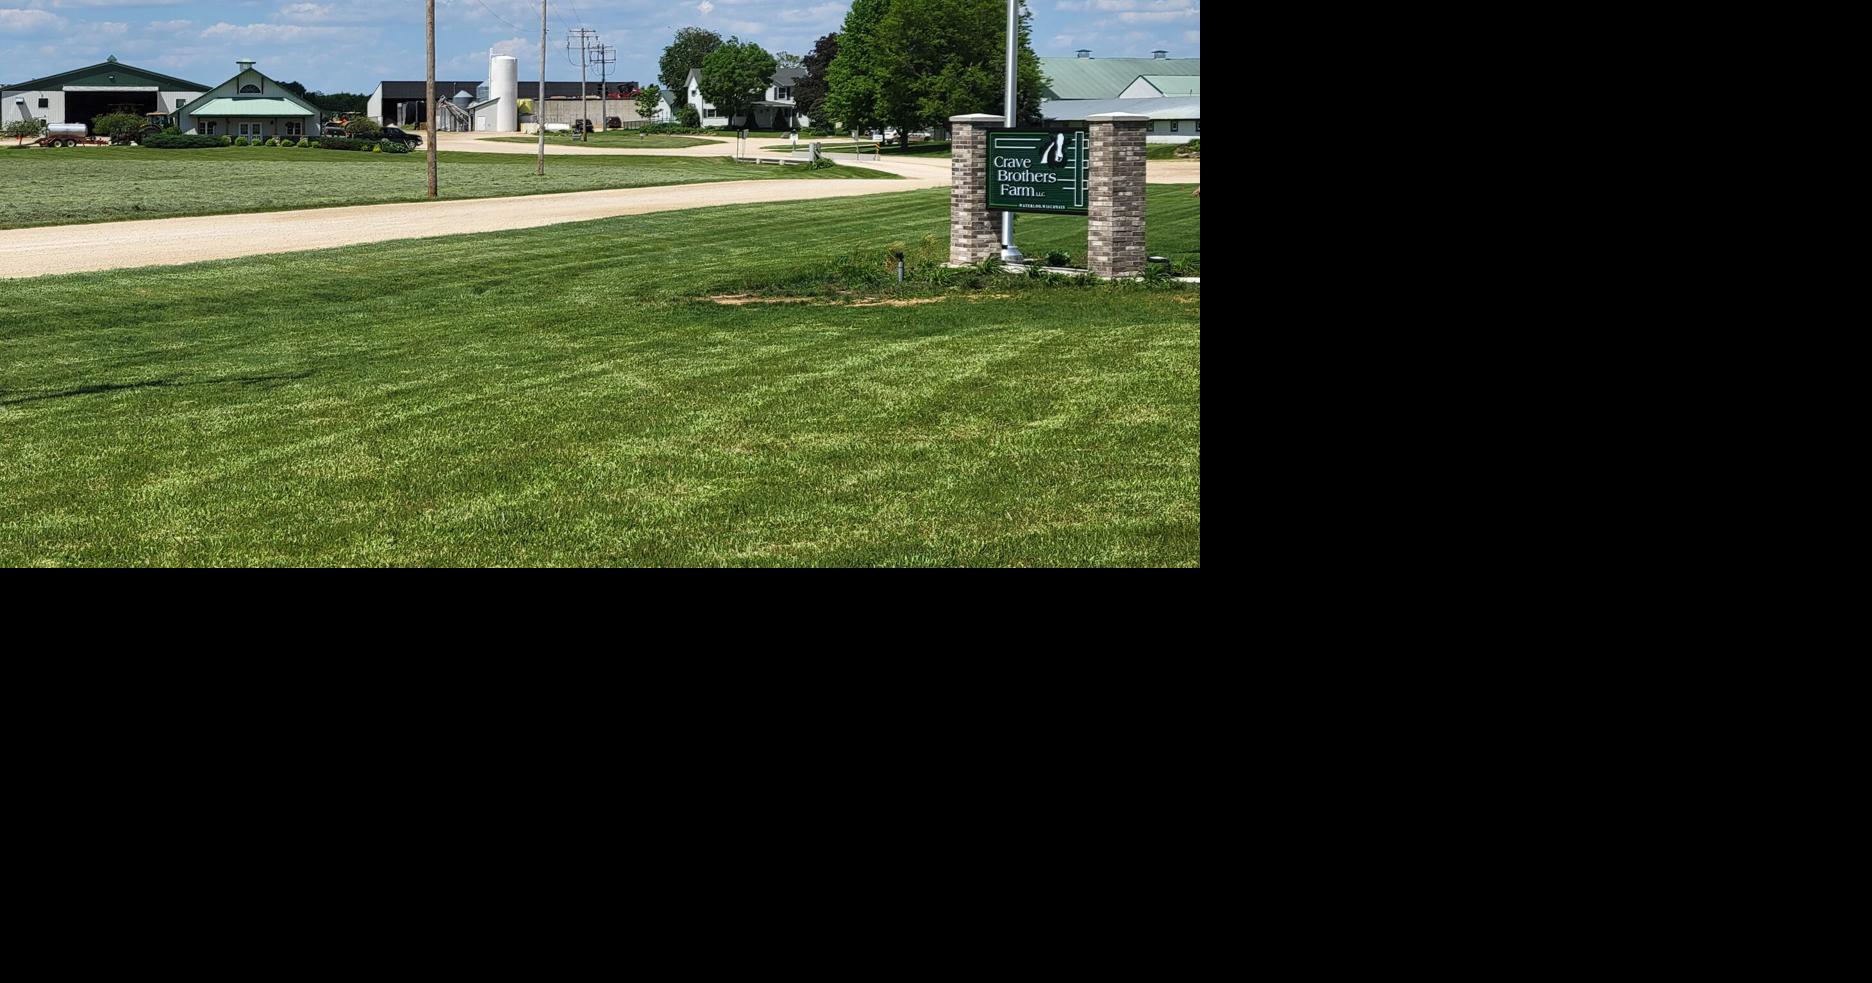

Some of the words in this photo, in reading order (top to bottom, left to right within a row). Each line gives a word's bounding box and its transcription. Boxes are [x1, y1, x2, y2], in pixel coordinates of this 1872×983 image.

[994, 156, 1031, 168] Crave
[998, 169, 1057, 183] Brothers
[1000, 184, 1035, 196] Farm
